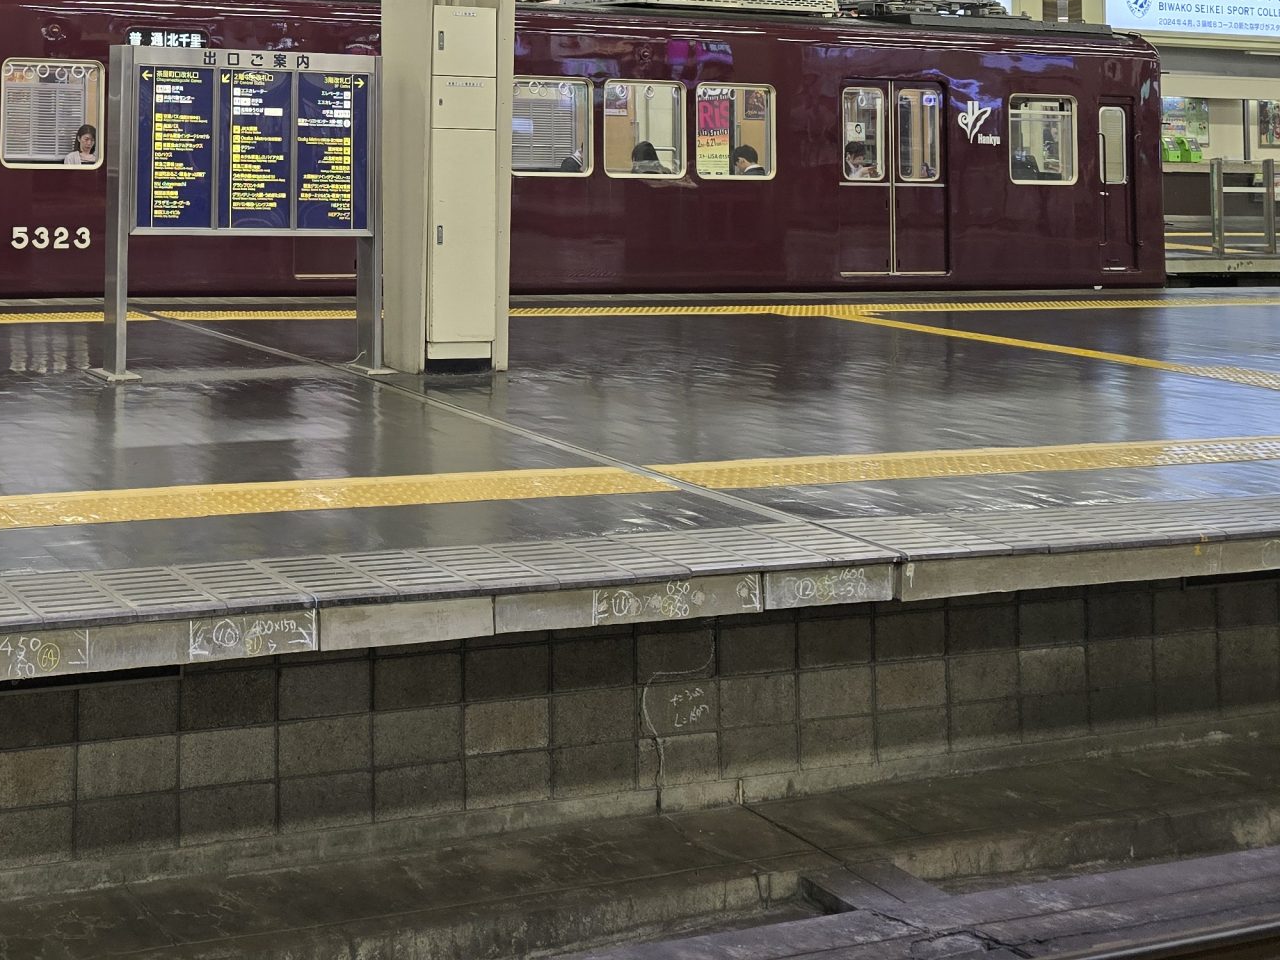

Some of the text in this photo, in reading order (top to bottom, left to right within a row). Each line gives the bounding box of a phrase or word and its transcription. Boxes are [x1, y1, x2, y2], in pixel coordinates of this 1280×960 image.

[1158, 2, 1192, 13] BIWAKO
[1195, 3, 1224, 15] SEIKEI
[1227, 6, 1255, 16] SPORT
[167, 32, 202, 48] 北千里
[203, 51, 310, 68] 出口ご案内
[977, 133, 1001, 146] Hankyu
[10, 226, 91, 250] 5323
[0, 637, 41, 656] 450
